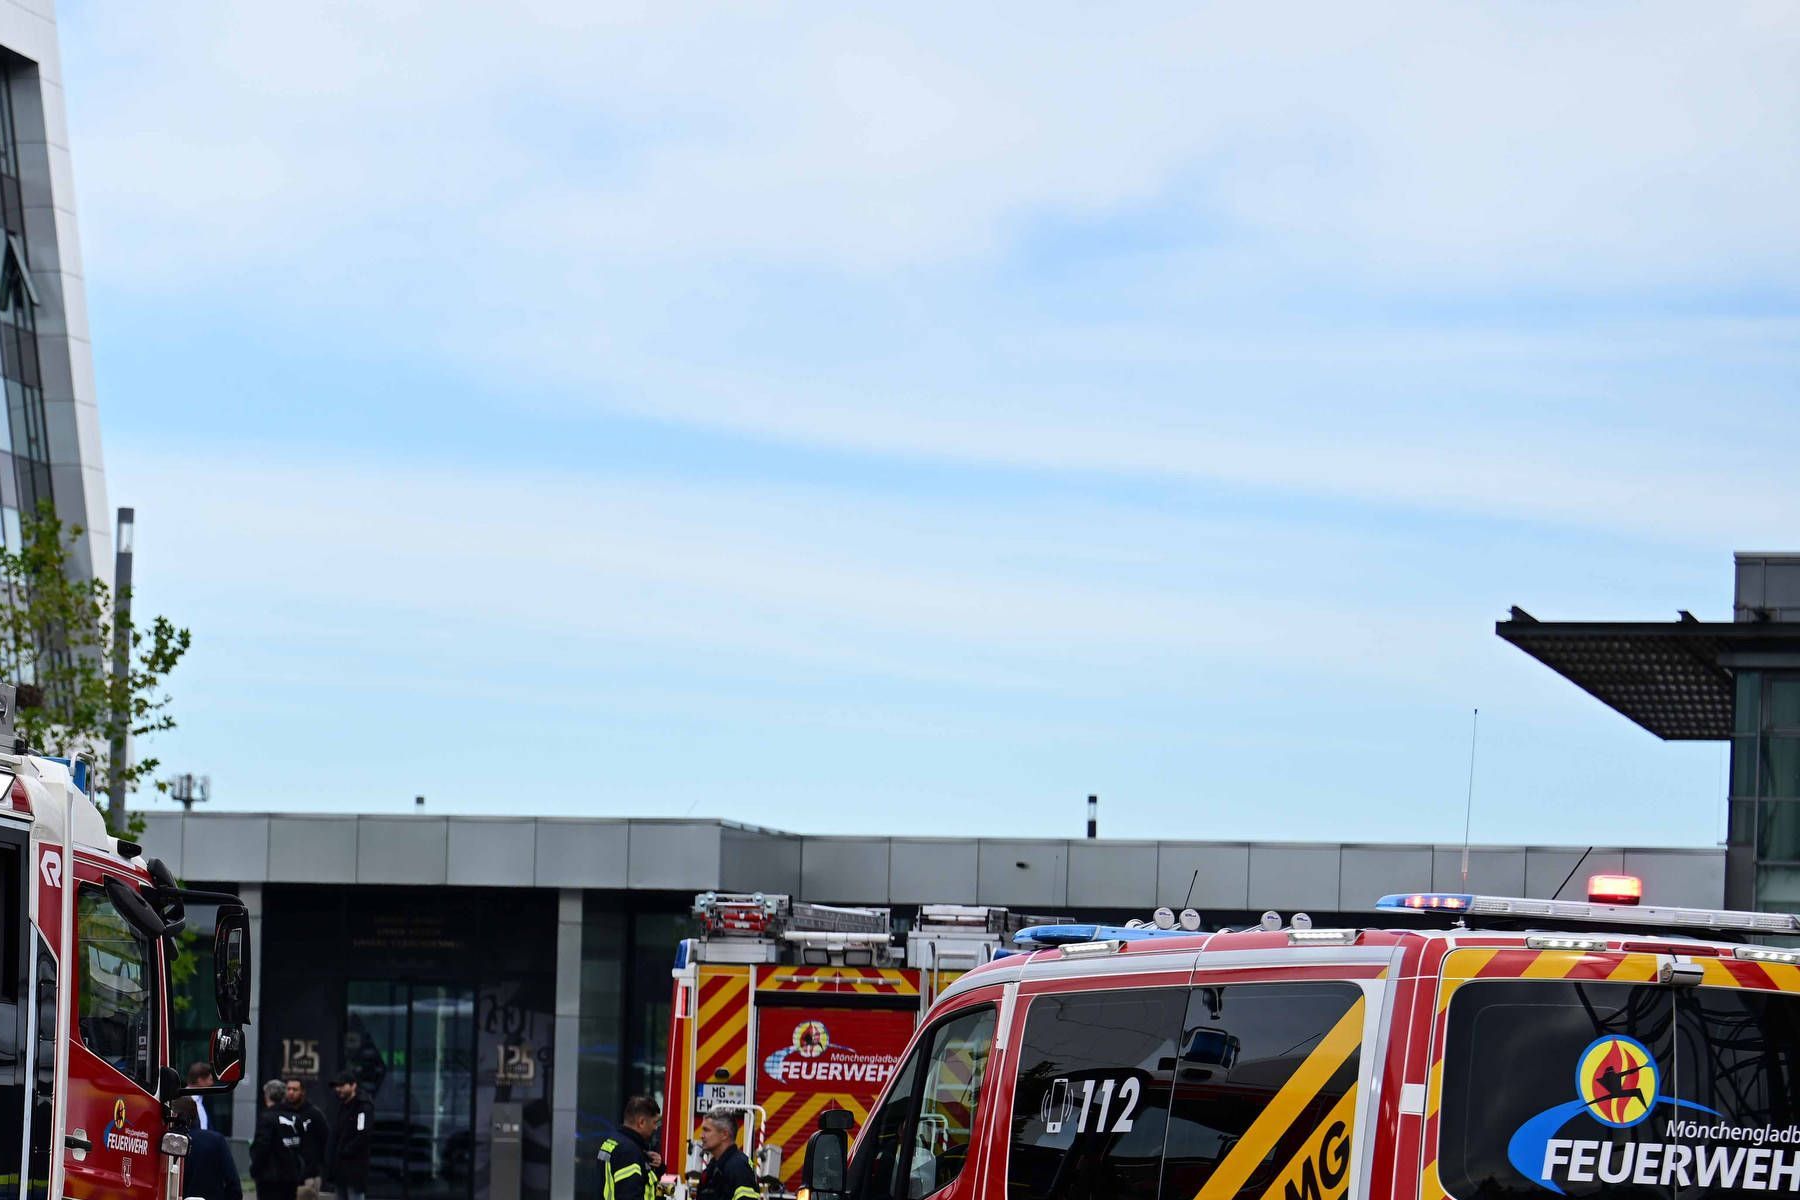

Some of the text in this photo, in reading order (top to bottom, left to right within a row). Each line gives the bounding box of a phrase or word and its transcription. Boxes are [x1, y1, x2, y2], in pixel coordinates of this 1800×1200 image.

[711, 1086, 726, 1098] MG
[1076, 1076, 1140, 1133] 112
[106, 1132, 149, 1156] FEUERWEHR
[1540, 1138, 1800, 1192] FEUERWEH
